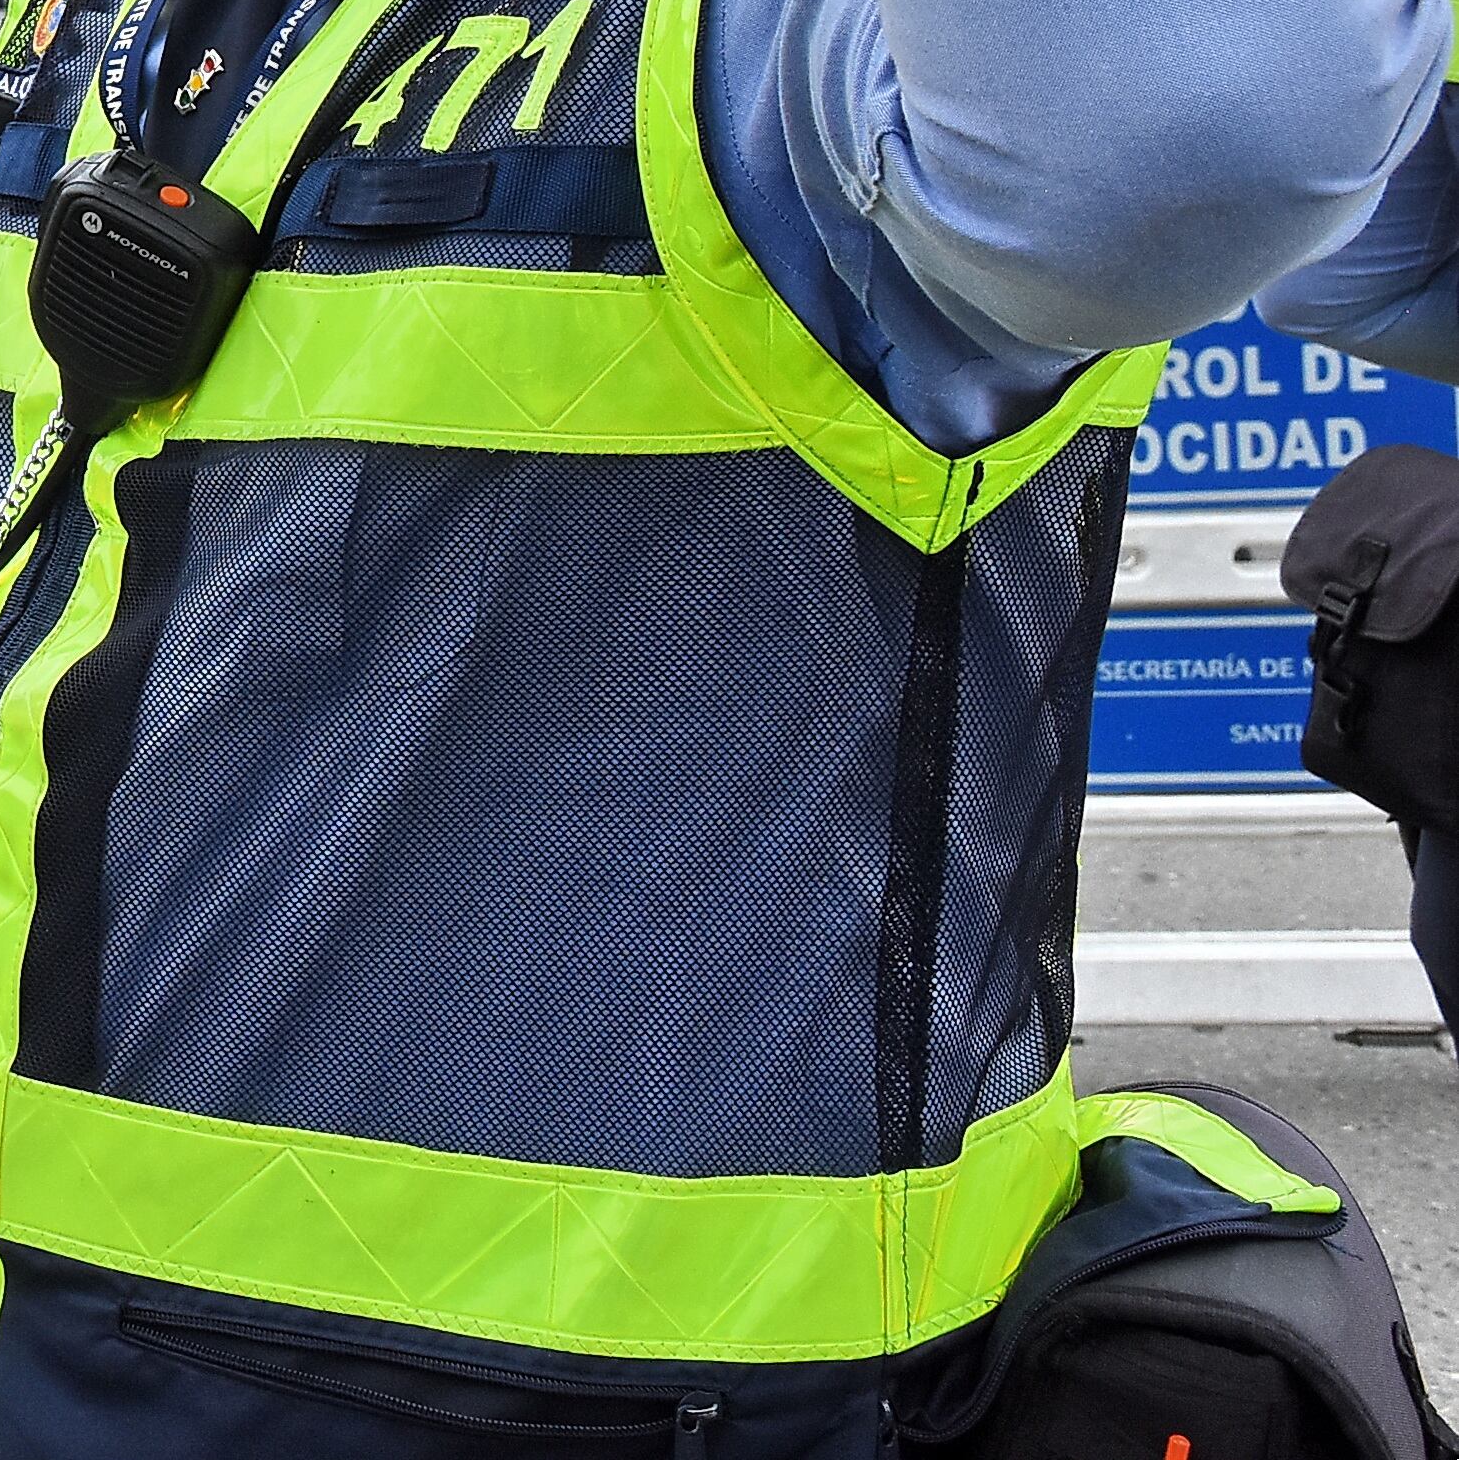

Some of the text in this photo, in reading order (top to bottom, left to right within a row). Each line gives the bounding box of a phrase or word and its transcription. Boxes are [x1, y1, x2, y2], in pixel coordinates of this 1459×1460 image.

[113, 26, 138, 52] DE
[105, 54, 137, 151] TRANSIT
[246, 75, 274, 109] DE
[106, 230, 189, 281] MOTOROLA
[1154, 343, 1387, 398] ROL DE
[1130, 417, 1367, 475] OCIDAD
[1097, 653, 1252, 682] SECRETARÍA
[1259, 657, 1295, 678] DE
[1230, 723, 1304, 743] SANTI
